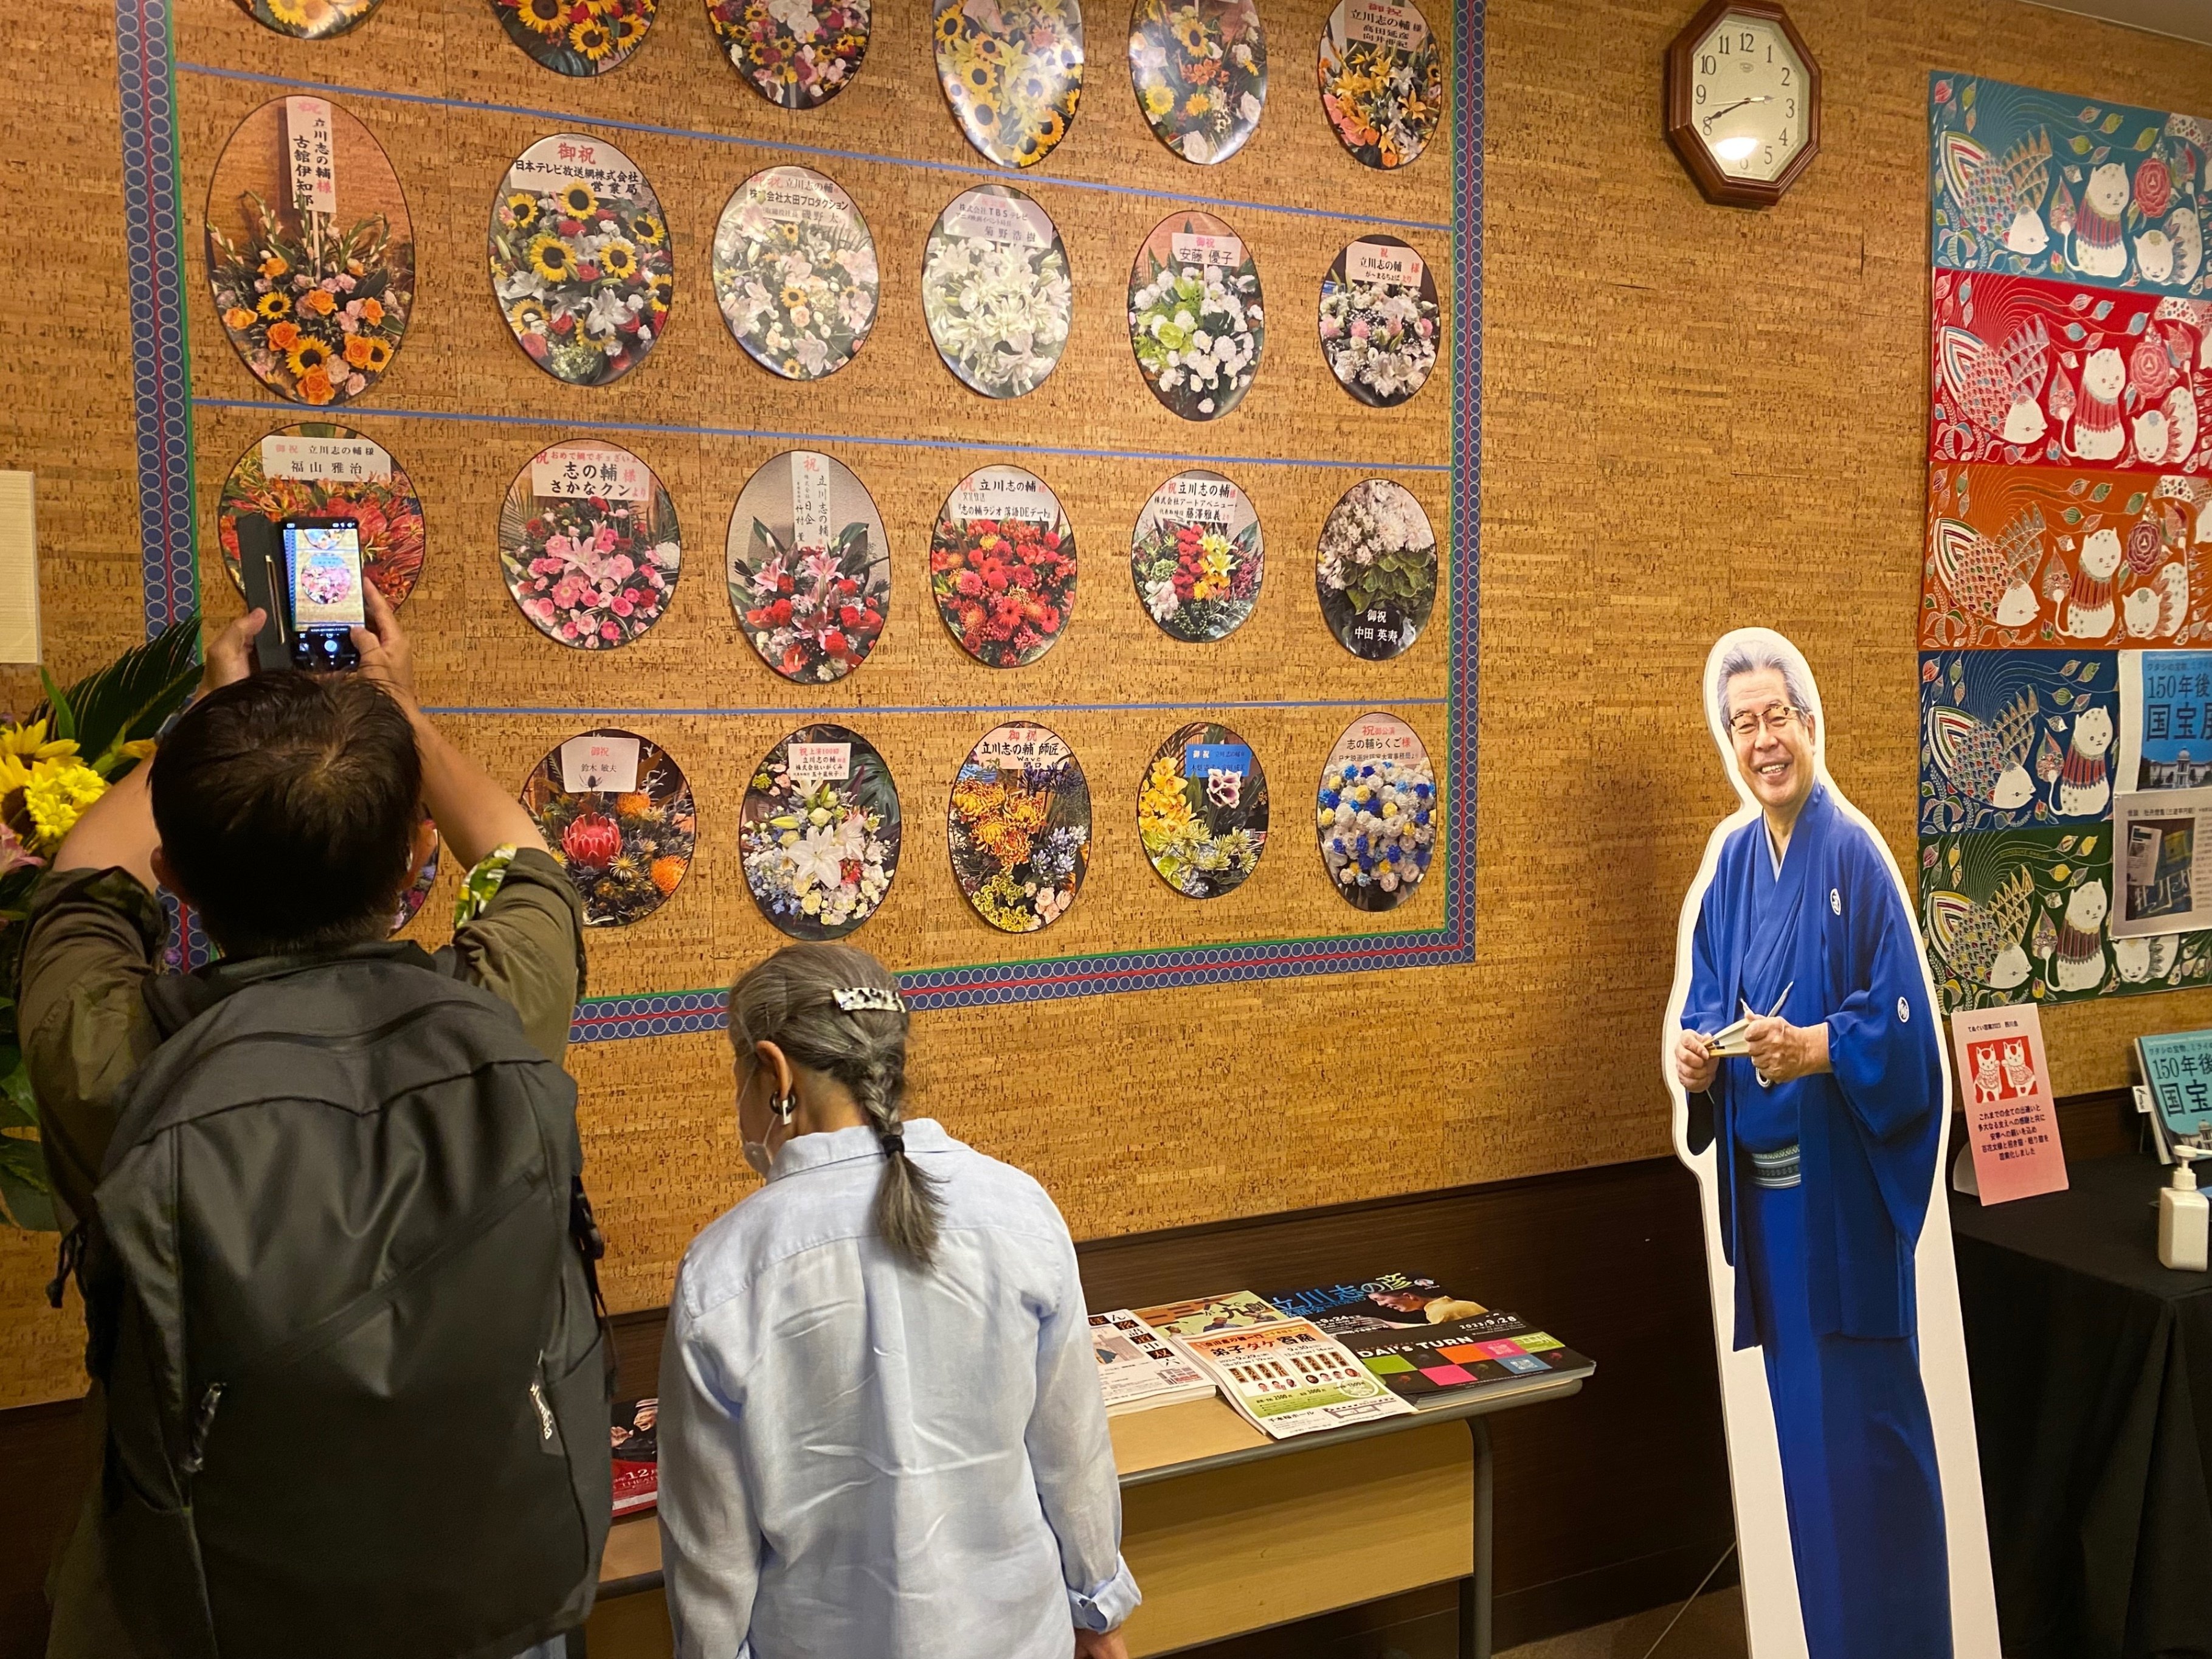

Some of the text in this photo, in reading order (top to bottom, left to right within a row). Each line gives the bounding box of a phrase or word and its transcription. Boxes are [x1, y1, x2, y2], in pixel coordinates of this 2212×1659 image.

[1719, 35, 1730, 55] 11
[1740, 32, 1754, 52] 12
[1766, 45, 1772, 63] 1
[1701, 55, 1716, 75] 10
[1781, 68, 1790, 86] 2
[1696, 84, 1706, 105] 9
[1785, 99, 1794, 118] 3
[1702, 116, 1712, 136] 8
[1778, 128, 1788, 147] 4
[558, 142, 596, 165] 御祝
[1764, 146, 1773, 165] 5
[516, 160, 638, 182] 日本テレビ放送網株式会社
[591, 181, 637, 195] 営業局
[1180, 247, 1233, 265] 安藤 優子
[1381, 248, 1388, 258] 祝
[291, 460, 362, 475] 福山雅治
[803, 455, 820, 472] 祝
[1367, 609, 1387, 623] 御祝
[1355, 626, 1398, 643] 中田 英寿
[1008, 729, 1037, 741] 御祝
[981, 741, 1060, 756] 立川志の輔 師匠
[1415, 1335, 1474, 1351] TURN
